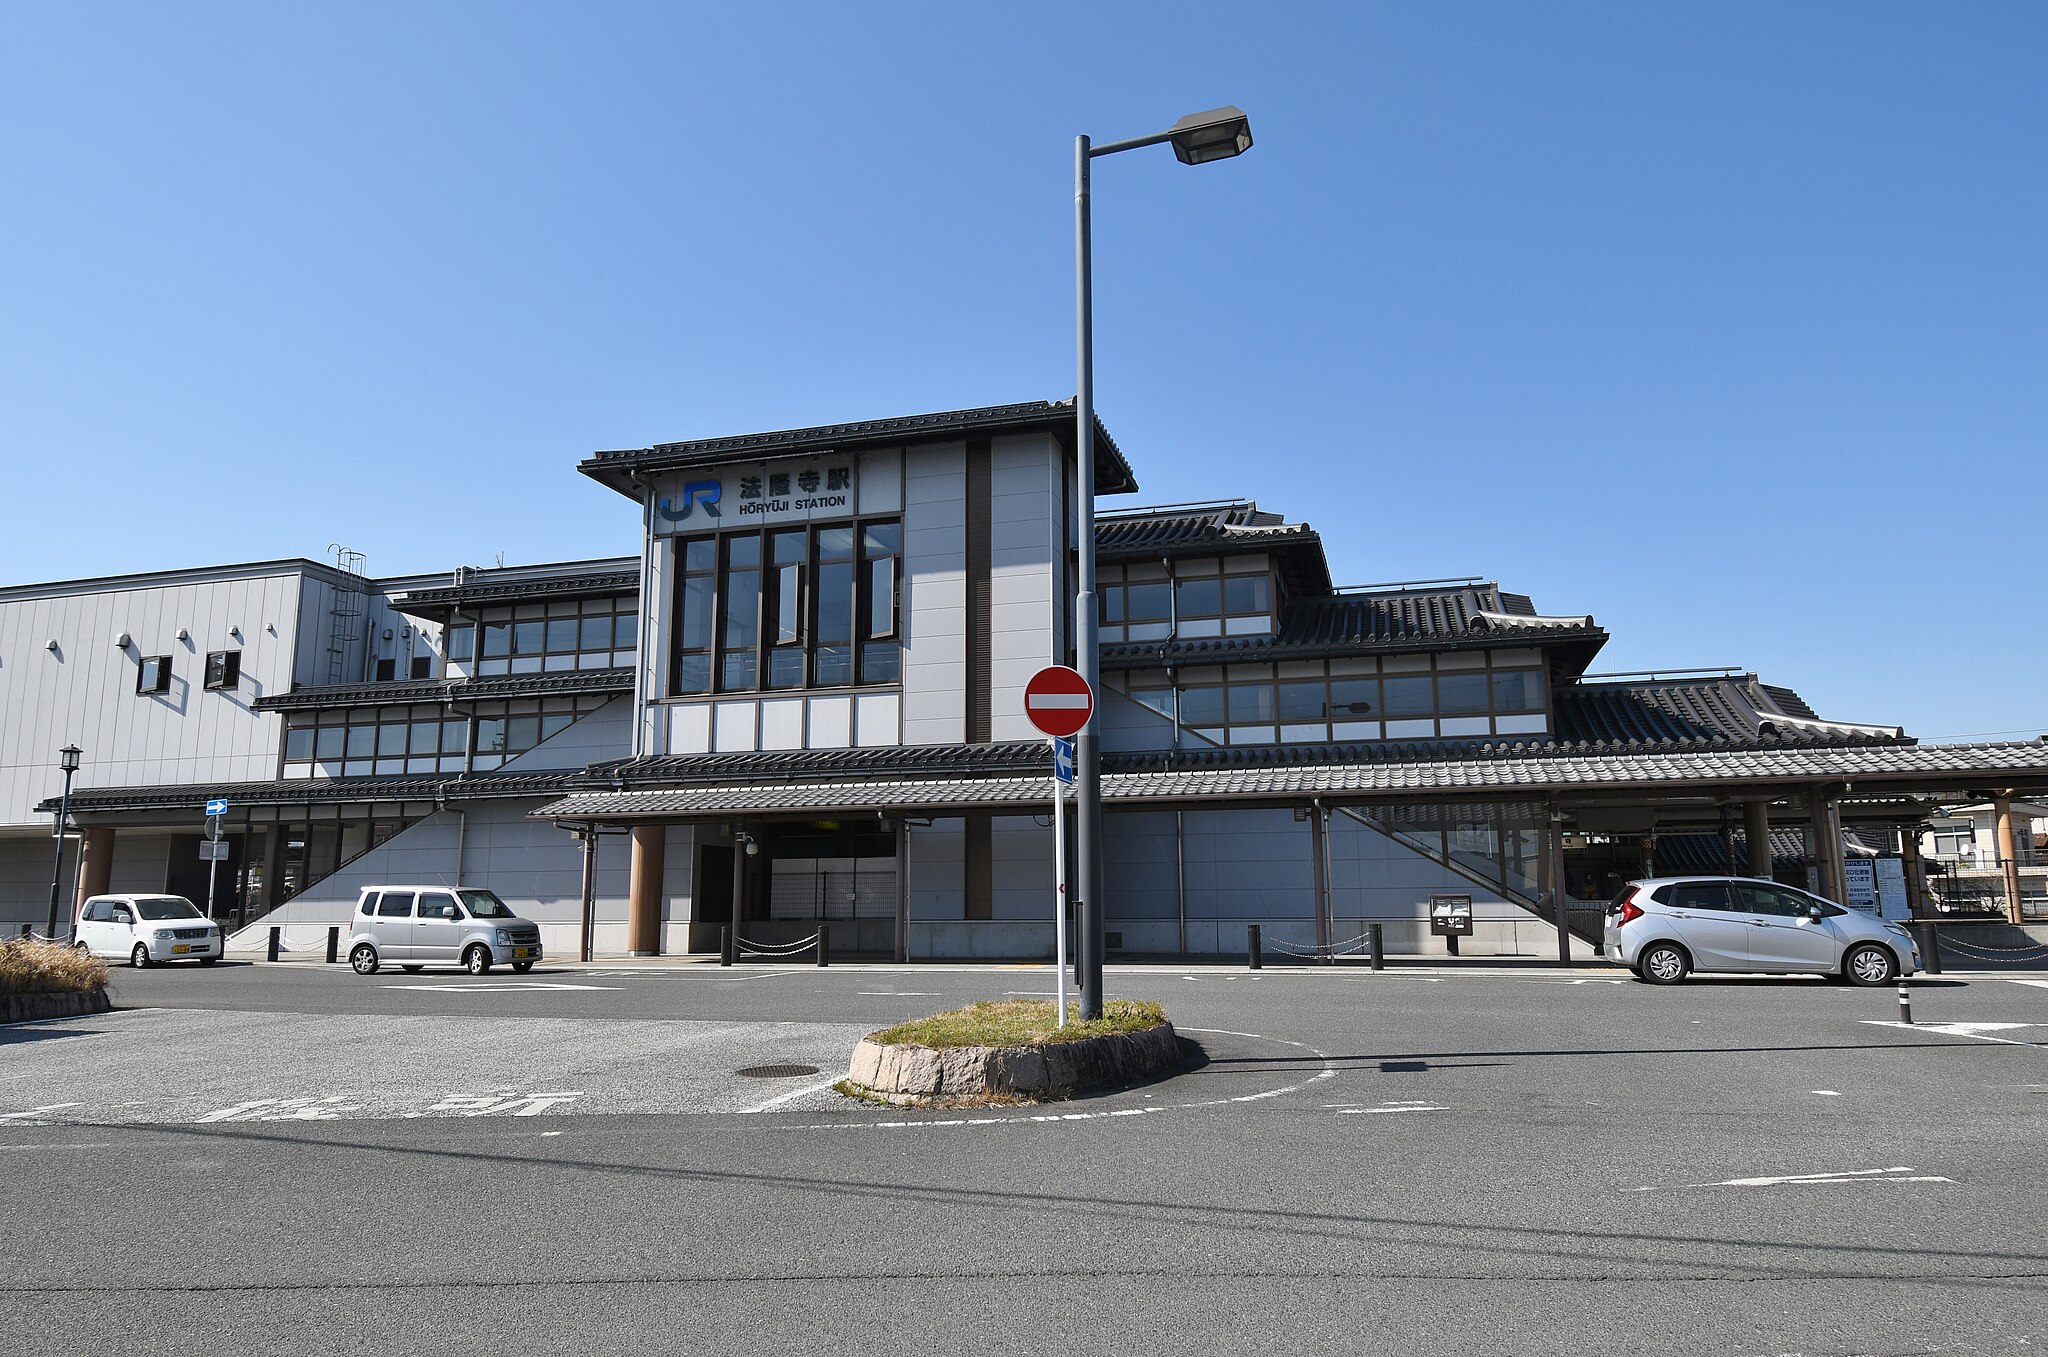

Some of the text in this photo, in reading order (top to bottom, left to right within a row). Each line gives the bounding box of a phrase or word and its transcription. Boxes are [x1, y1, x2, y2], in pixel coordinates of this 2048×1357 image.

[739, 467, 850, 500] 法隆寺駅
[660, 480, 722, 522] JR
[739, 496, 846, 516] HŌRYŪJI STATION
